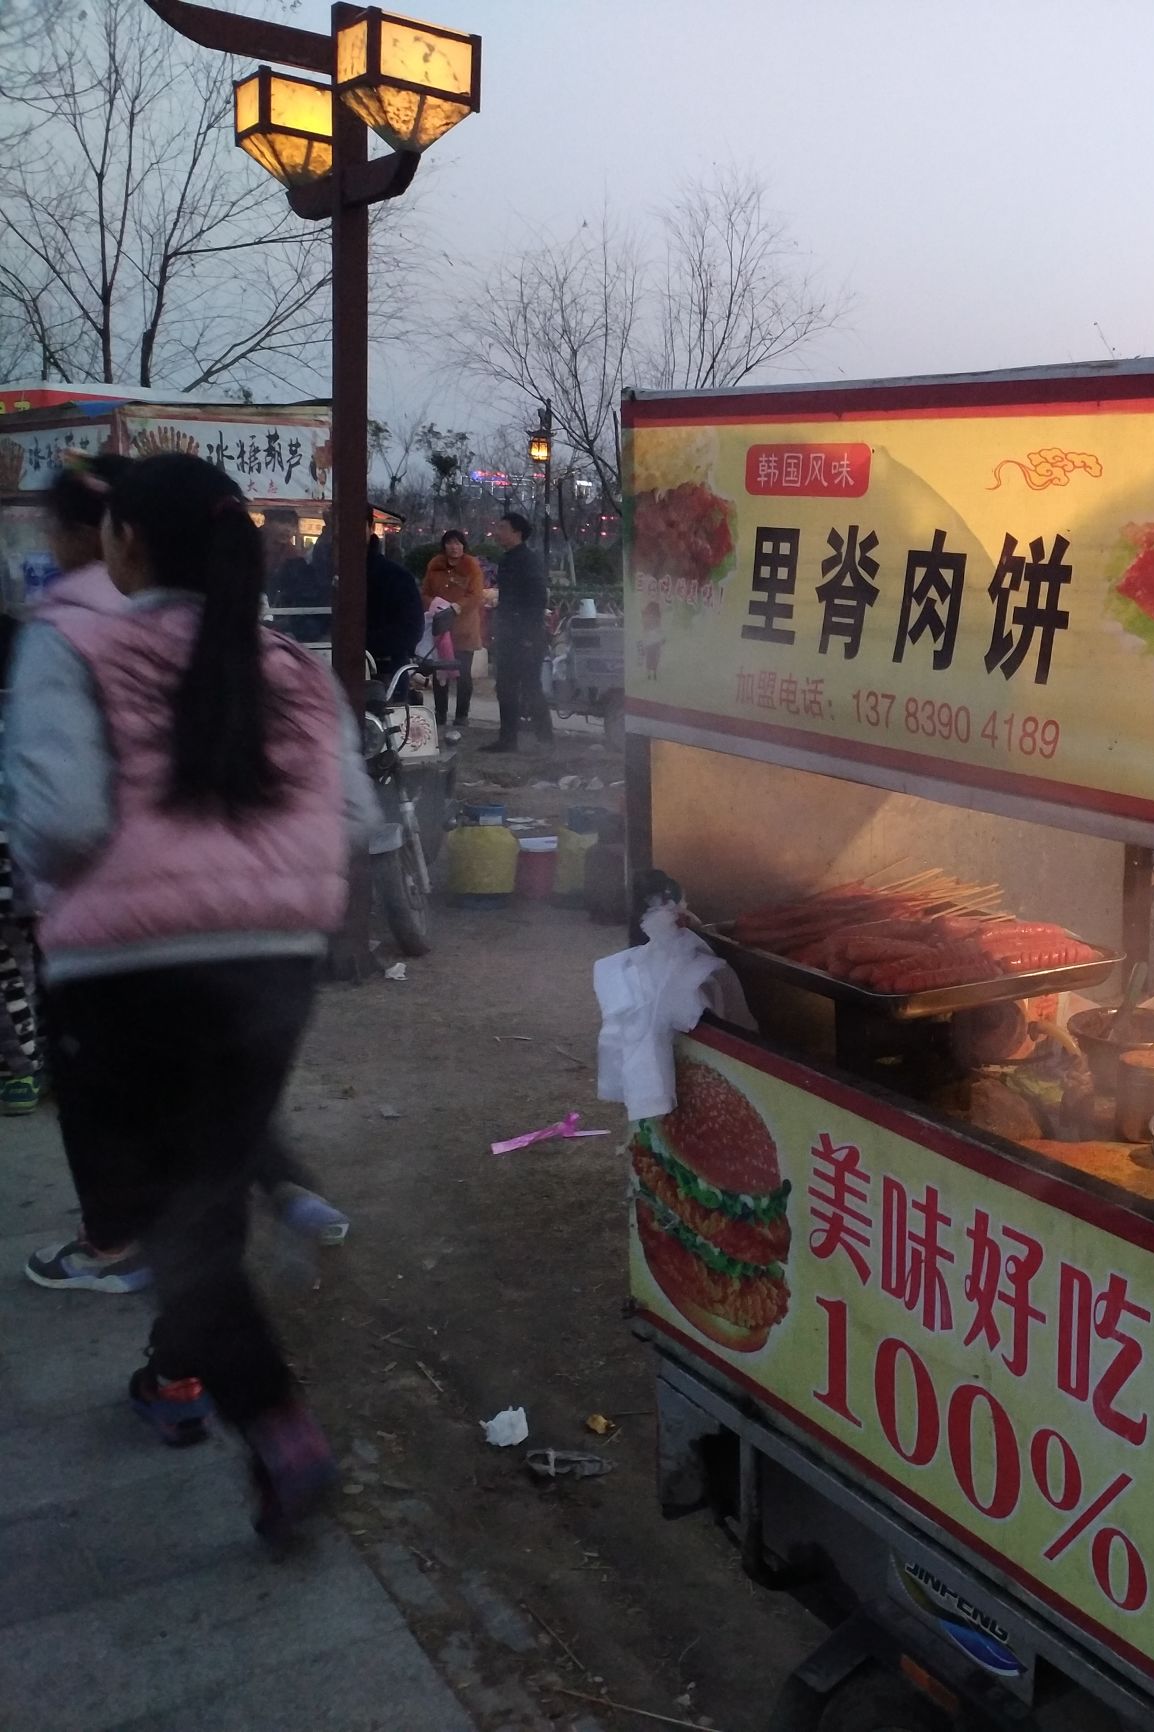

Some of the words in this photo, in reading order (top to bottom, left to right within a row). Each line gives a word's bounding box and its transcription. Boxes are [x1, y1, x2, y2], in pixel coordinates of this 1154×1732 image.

[756, 453, 855, 488] 韩国风味
[740, 524, 1073, 686] 里脊肉饼
[852, 688, 897, 729] 137
[904, 696, 971, 744] 8390
[980, 709, 1061, 760] 4189
[807, 1132, 1152, 1447] 美味好吃
[812, 1296, 1148, 1612] 100%
